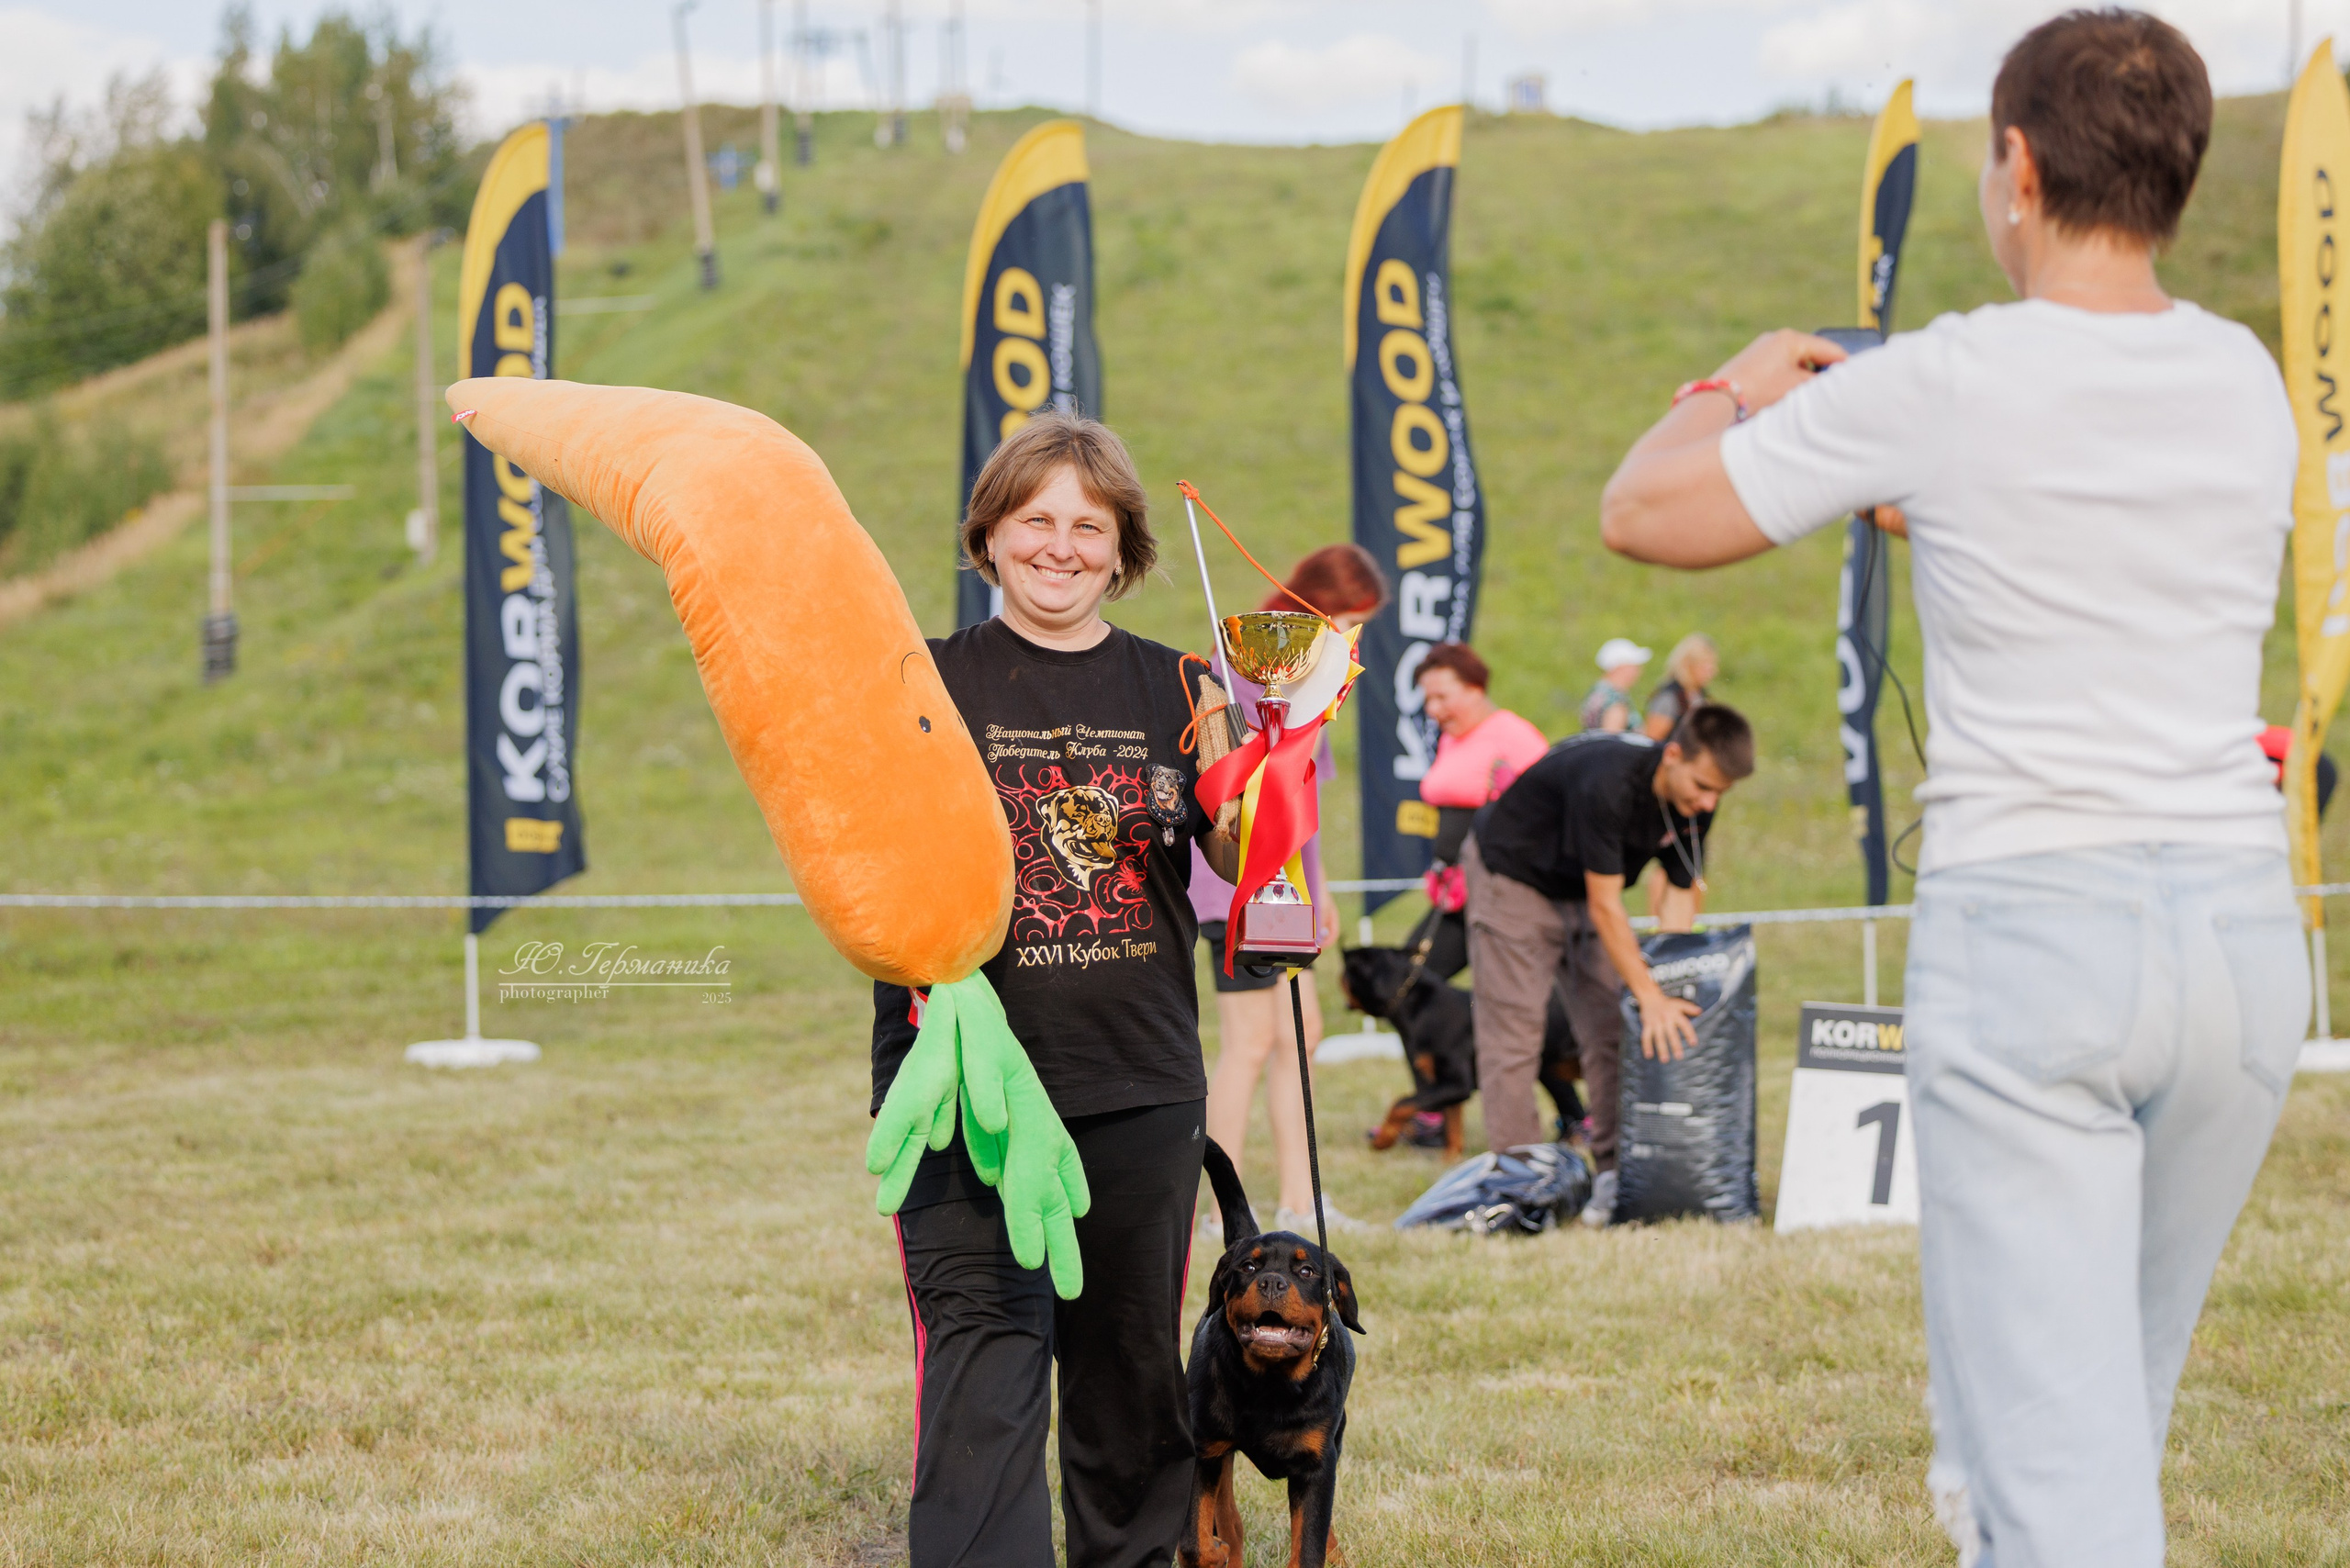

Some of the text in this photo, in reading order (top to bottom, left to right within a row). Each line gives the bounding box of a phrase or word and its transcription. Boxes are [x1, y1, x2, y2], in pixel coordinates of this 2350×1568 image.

[986, 723, 1146, 742] Национальный Чемпионат
[988, 743, 1060, 763] Победитель
[1065, 741, 1107, 760] Клуба
[1016, 938, 1158, 969] XXVI Кубок Твери
[1811, 1018, 1908, 1051] KORW
[1857, 1102, 1900, 1204] 1
